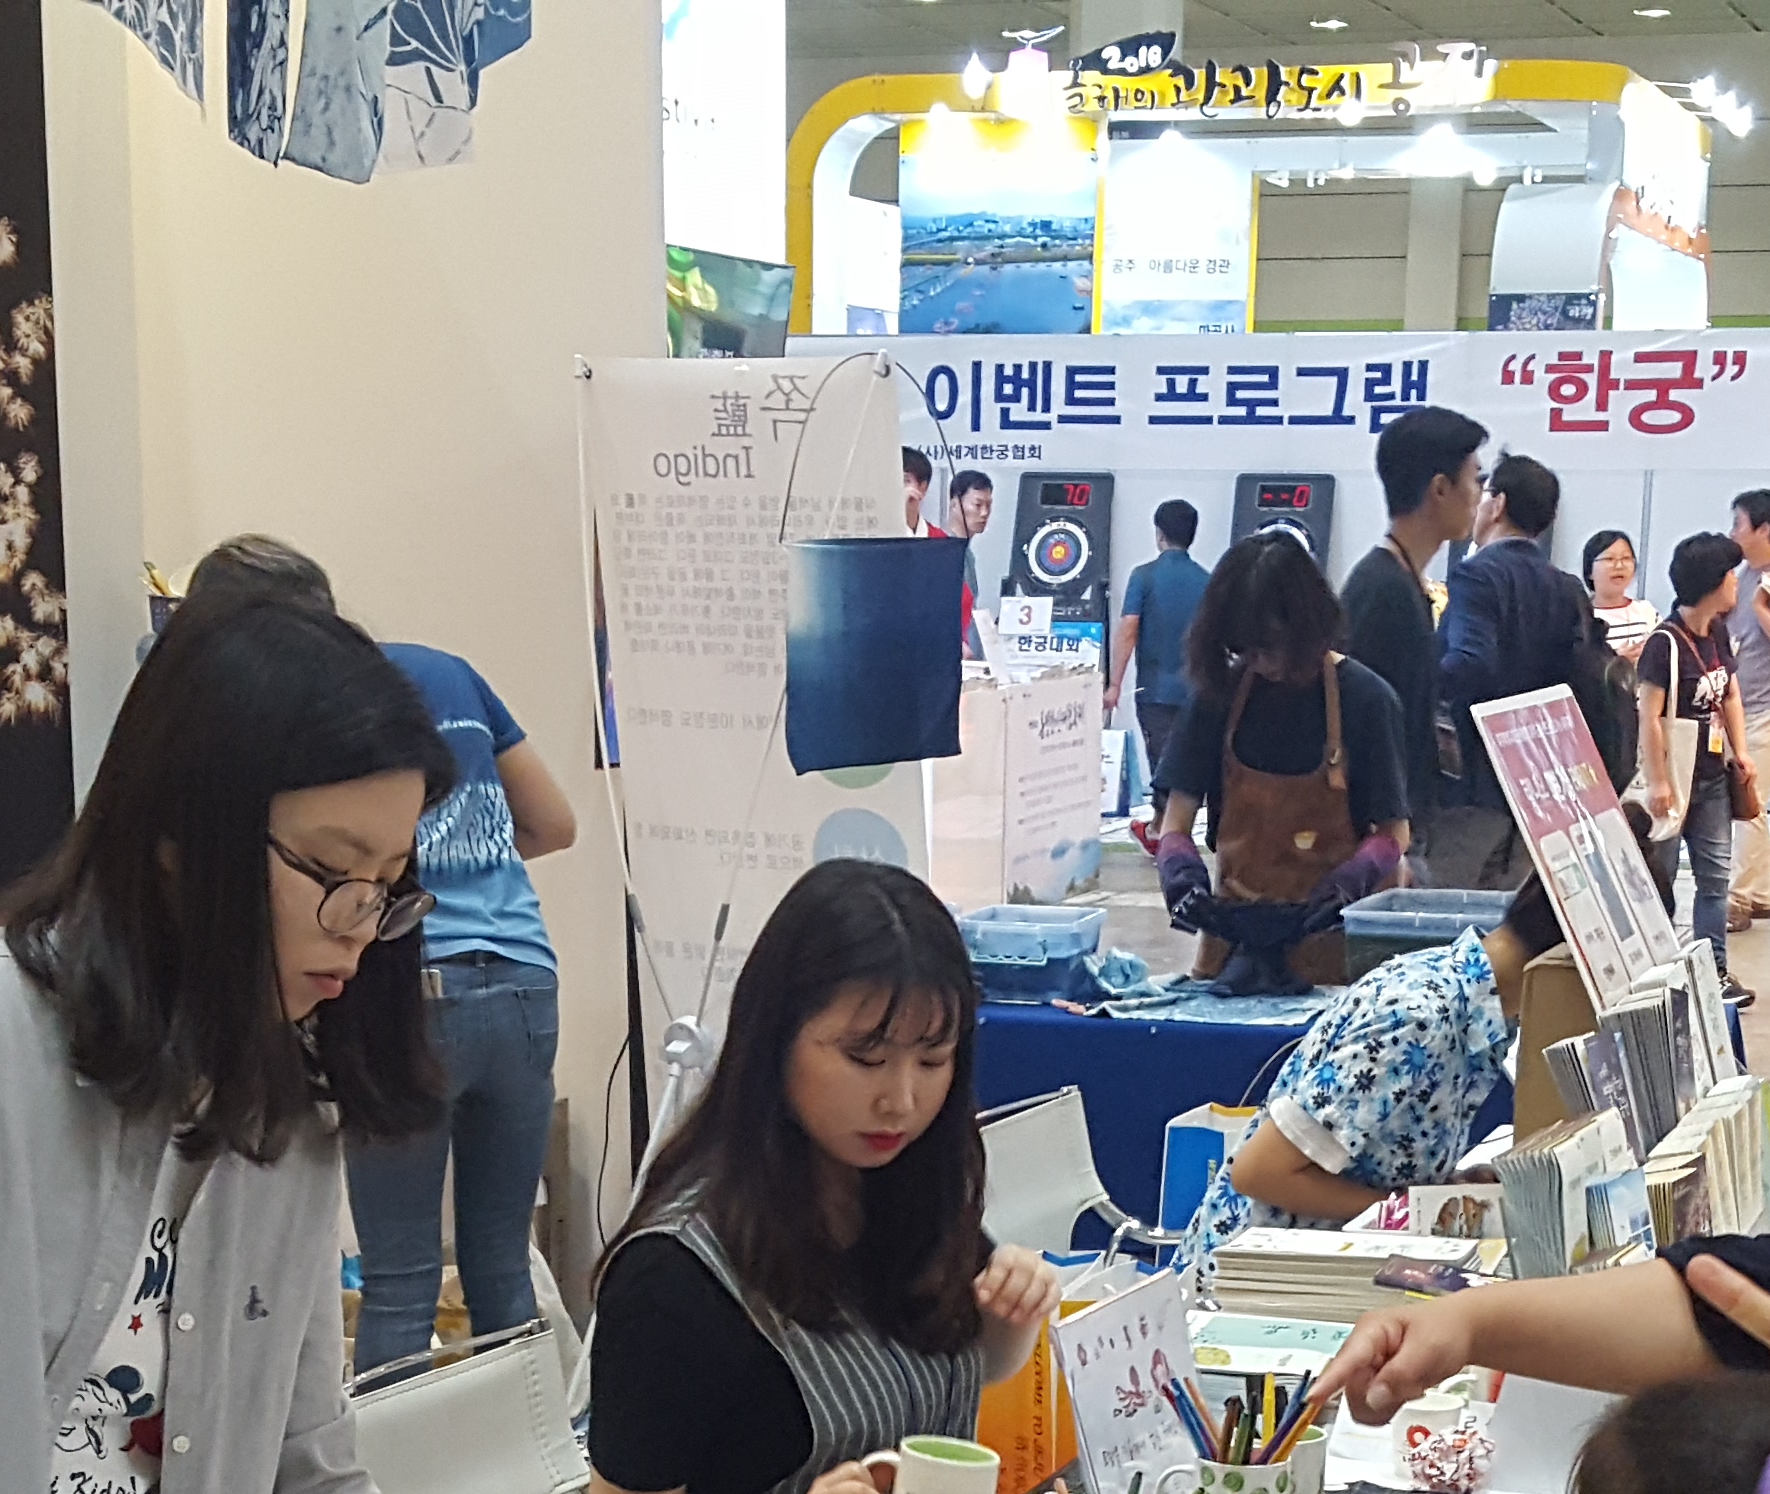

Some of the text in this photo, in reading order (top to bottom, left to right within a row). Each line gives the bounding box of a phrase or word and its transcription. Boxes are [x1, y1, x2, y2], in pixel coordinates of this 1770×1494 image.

[1101, 44, 1164, 73] 2018
[1168, 57, 1367, 119] 관광도시
[924, 358, 1123, 432] 이벤트
[1147, 358, 1431, 434] 프로그램
[1018, 604, 1034, 626] 3
